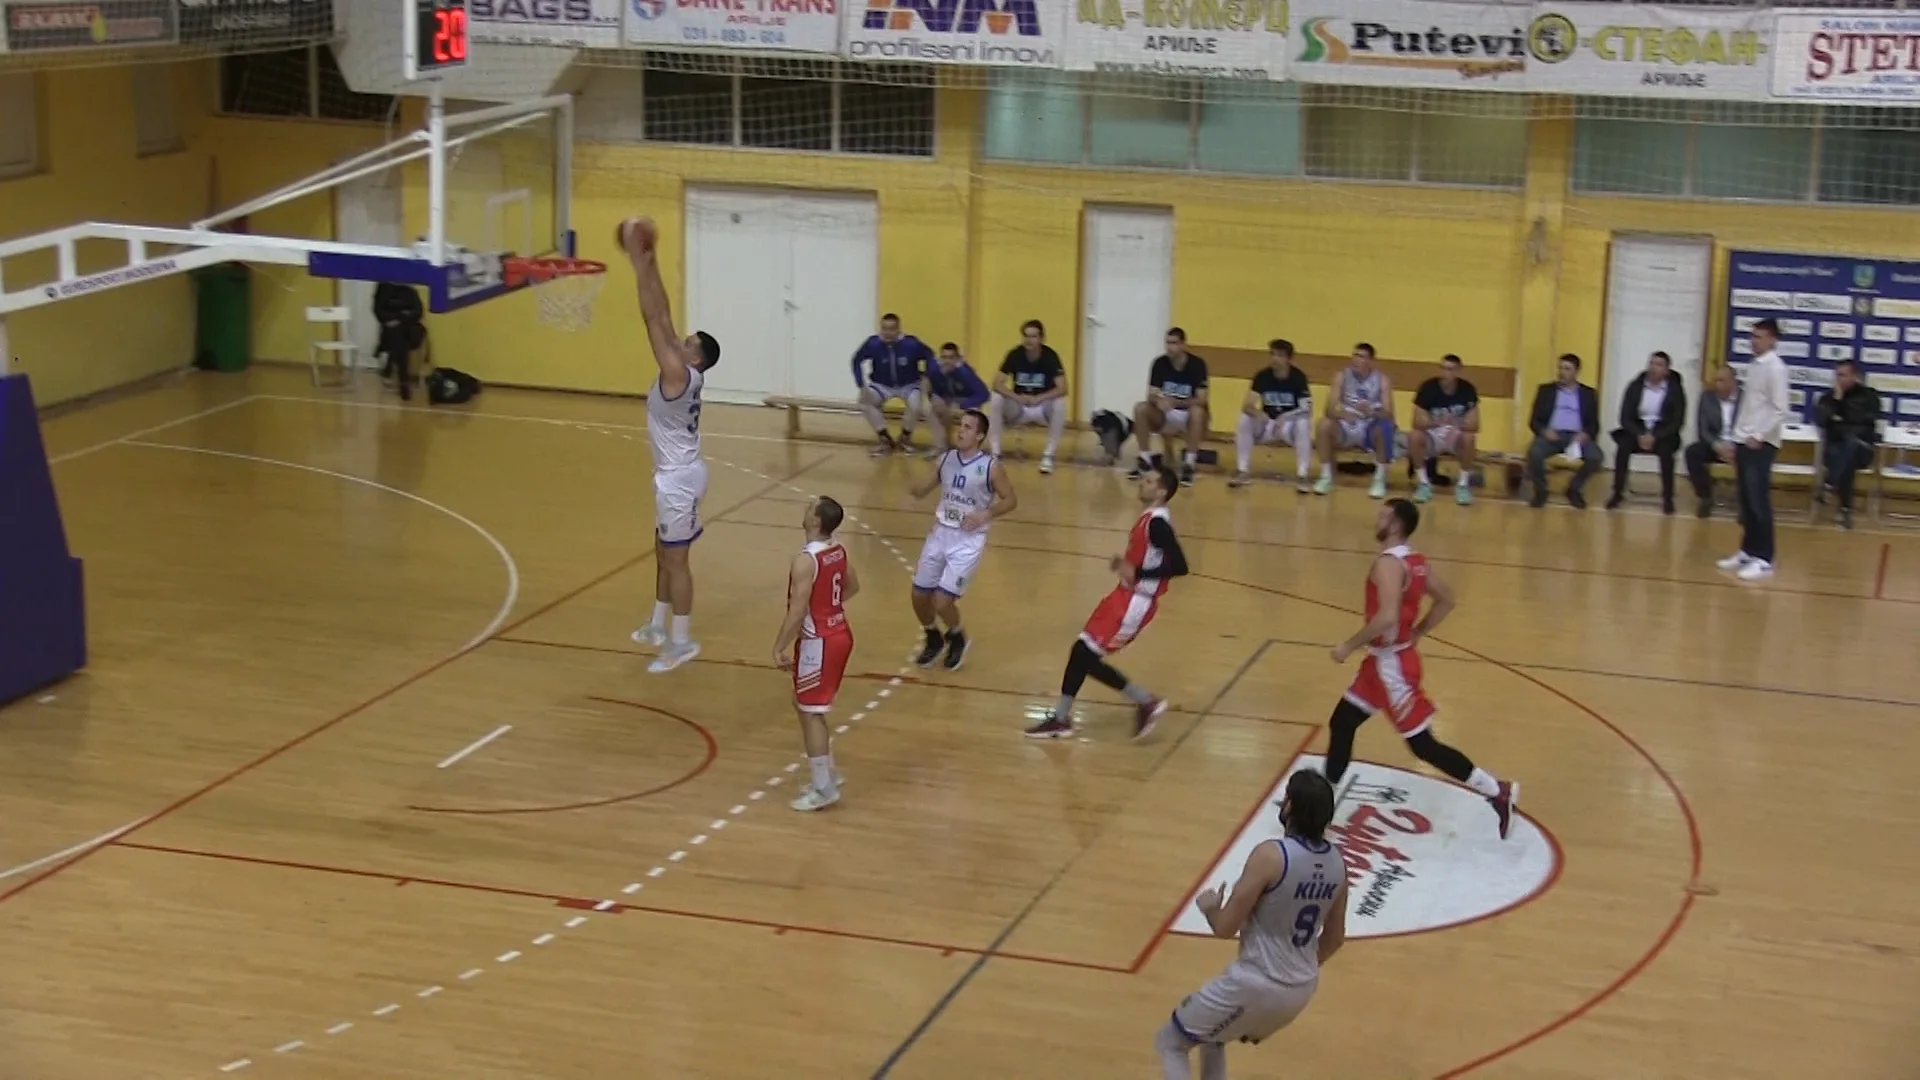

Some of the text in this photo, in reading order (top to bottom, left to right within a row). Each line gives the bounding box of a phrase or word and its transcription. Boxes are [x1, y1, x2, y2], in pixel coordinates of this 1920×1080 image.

[433, 9, 466, 62] 20
[1350, 22, 1526, 57] Putevi
[951, 473, 967, 490] 10
[831, 571, 842, 607] 6
[1291, 903, 1321, 948] 9
